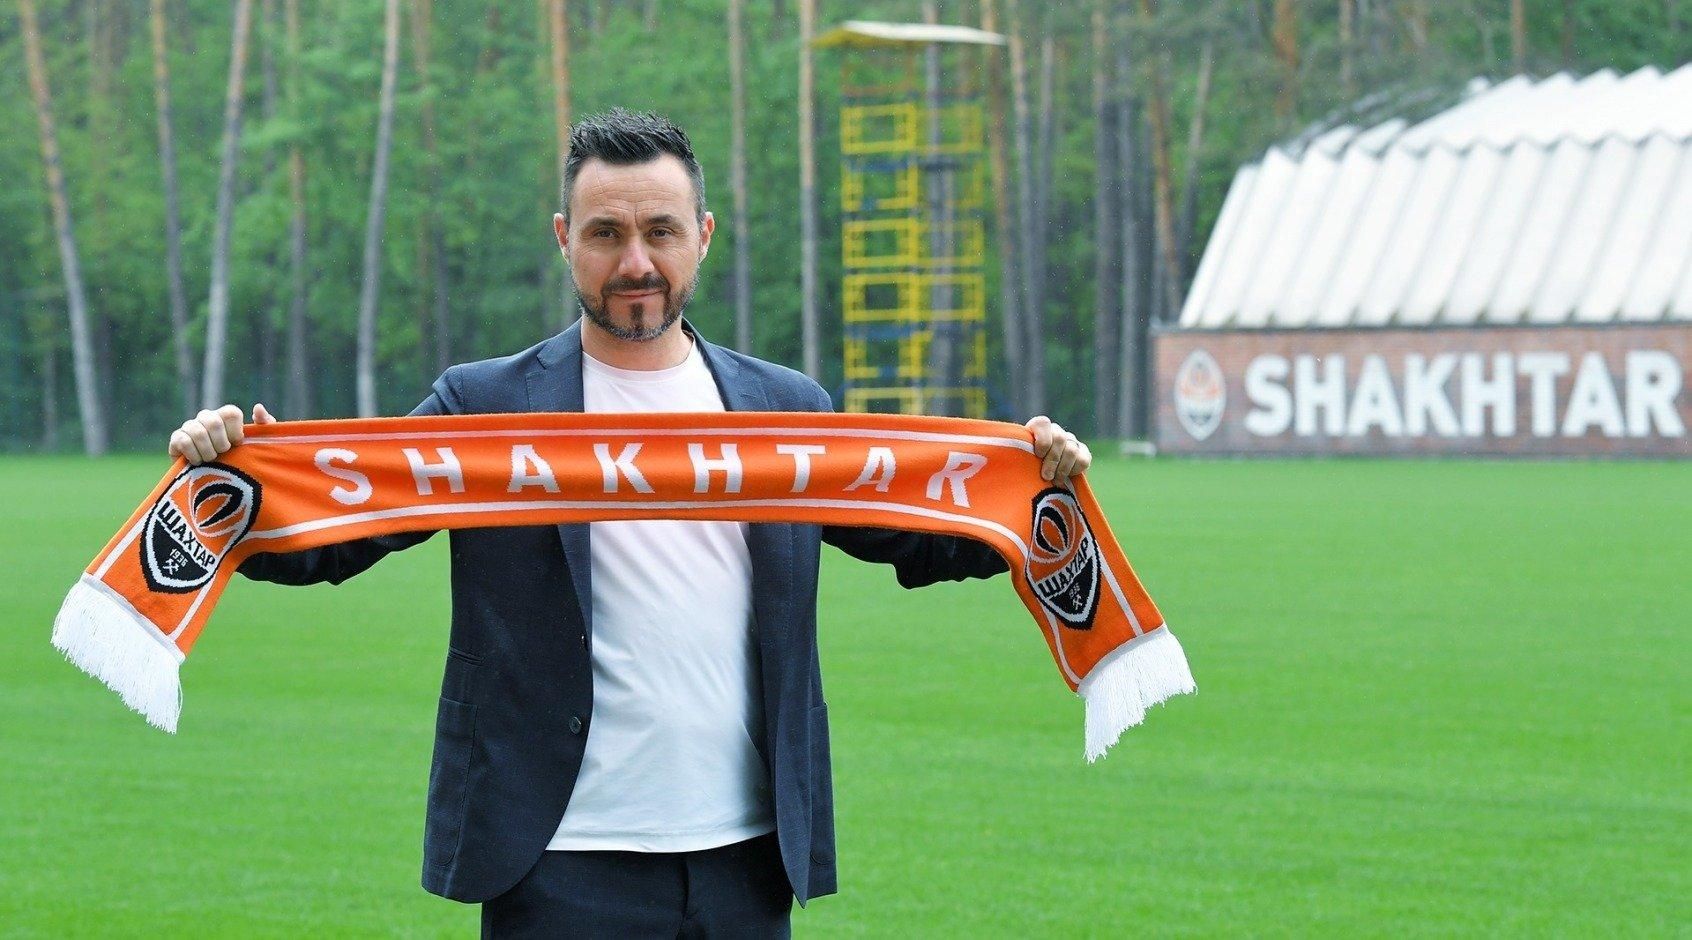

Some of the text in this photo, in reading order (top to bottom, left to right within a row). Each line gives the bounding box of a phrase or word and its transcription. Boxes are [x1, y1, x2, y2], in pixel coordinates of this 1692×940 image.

[1244, 350, 1685, 437] SHAKHTAR
[314, 442, 988, 508] SHAKHTAR
[157, 501, 216, 567] ШАХТАР
[170, 548, 189, 567] 1936
